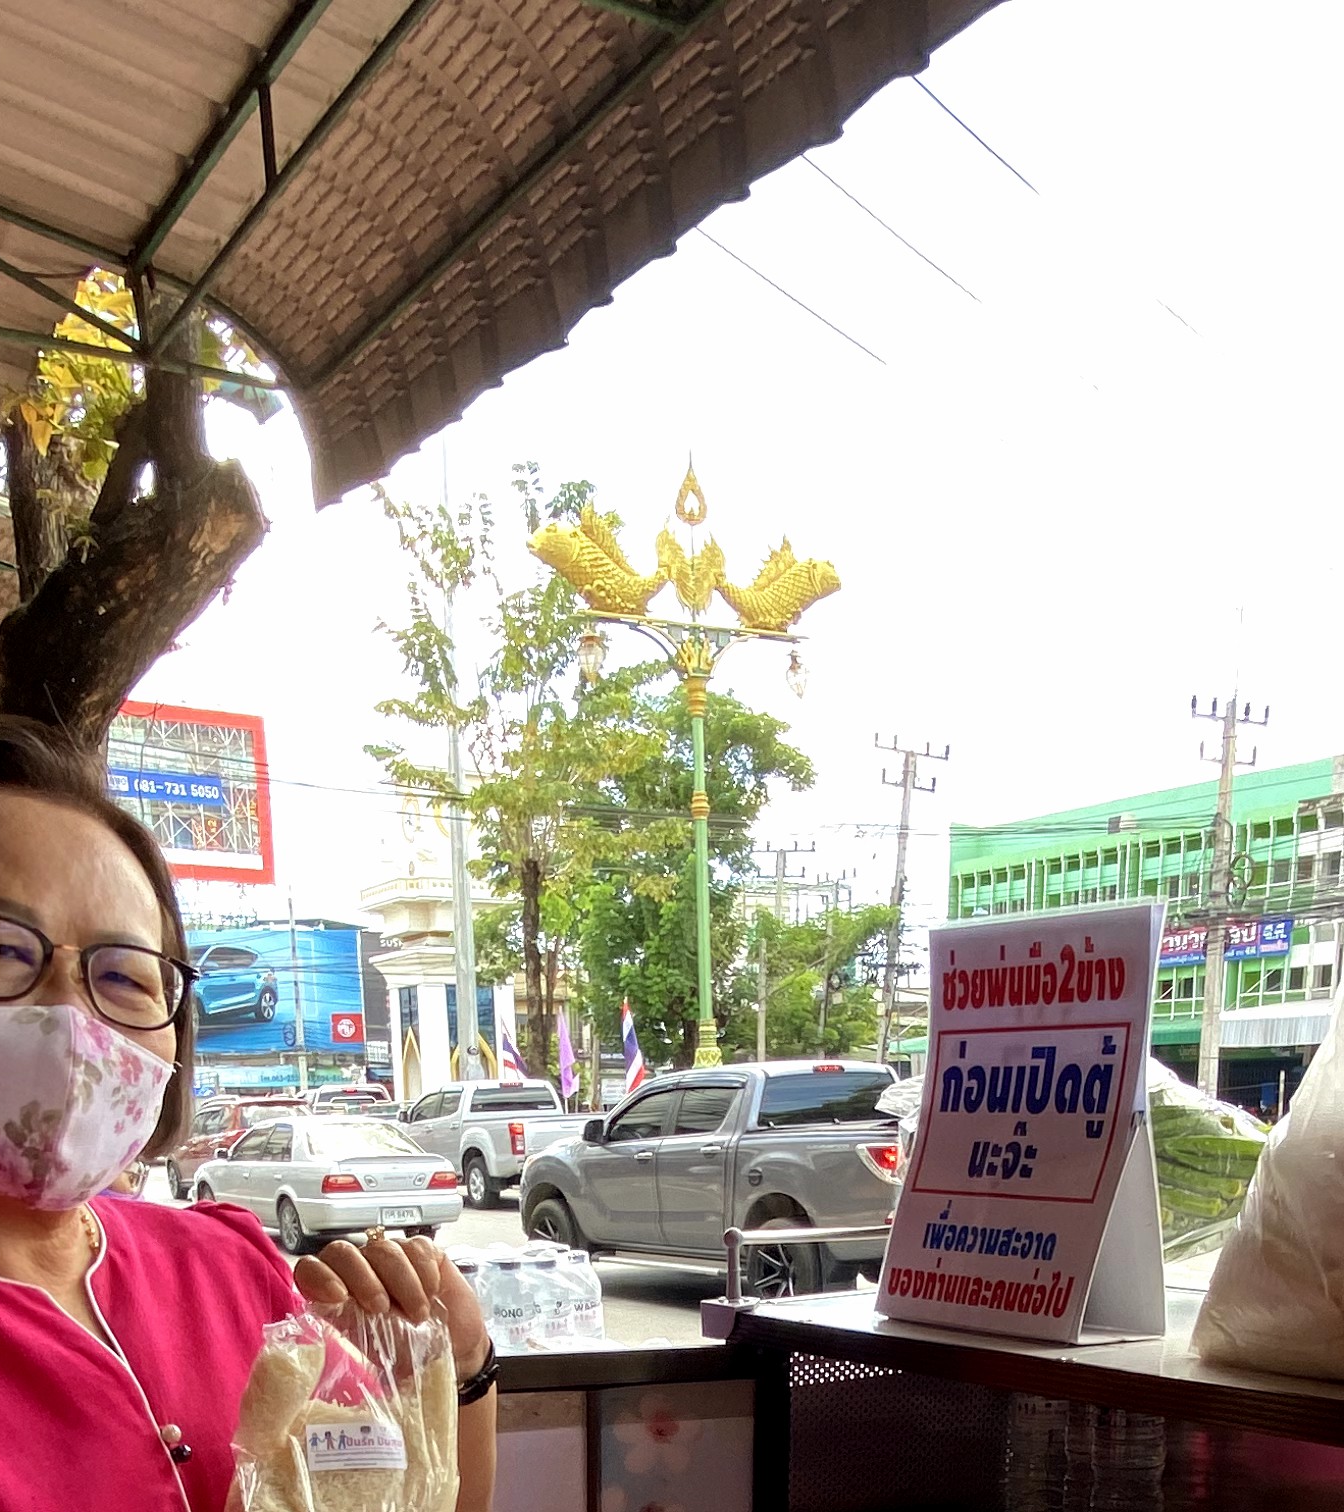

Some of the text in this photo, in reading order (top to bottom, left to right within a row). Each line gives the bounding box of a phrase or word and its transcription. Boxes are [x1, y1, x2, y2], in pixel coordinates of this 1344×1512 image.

[191, 784, 220, 799] 5050
[942, 936, 1126, 1011] ช่วยพ่นมือ2ข้าง
[939, 1035, 1117, 1139] ก่อนเปิดตู้
[967, 1121, 1038, 1180] นะจ๊ะ
[922, 1199, 1057, 1261] เพื่อความสะอาด
[887, 1256, 1075, 1318] ของท่านและคนต่อไป
